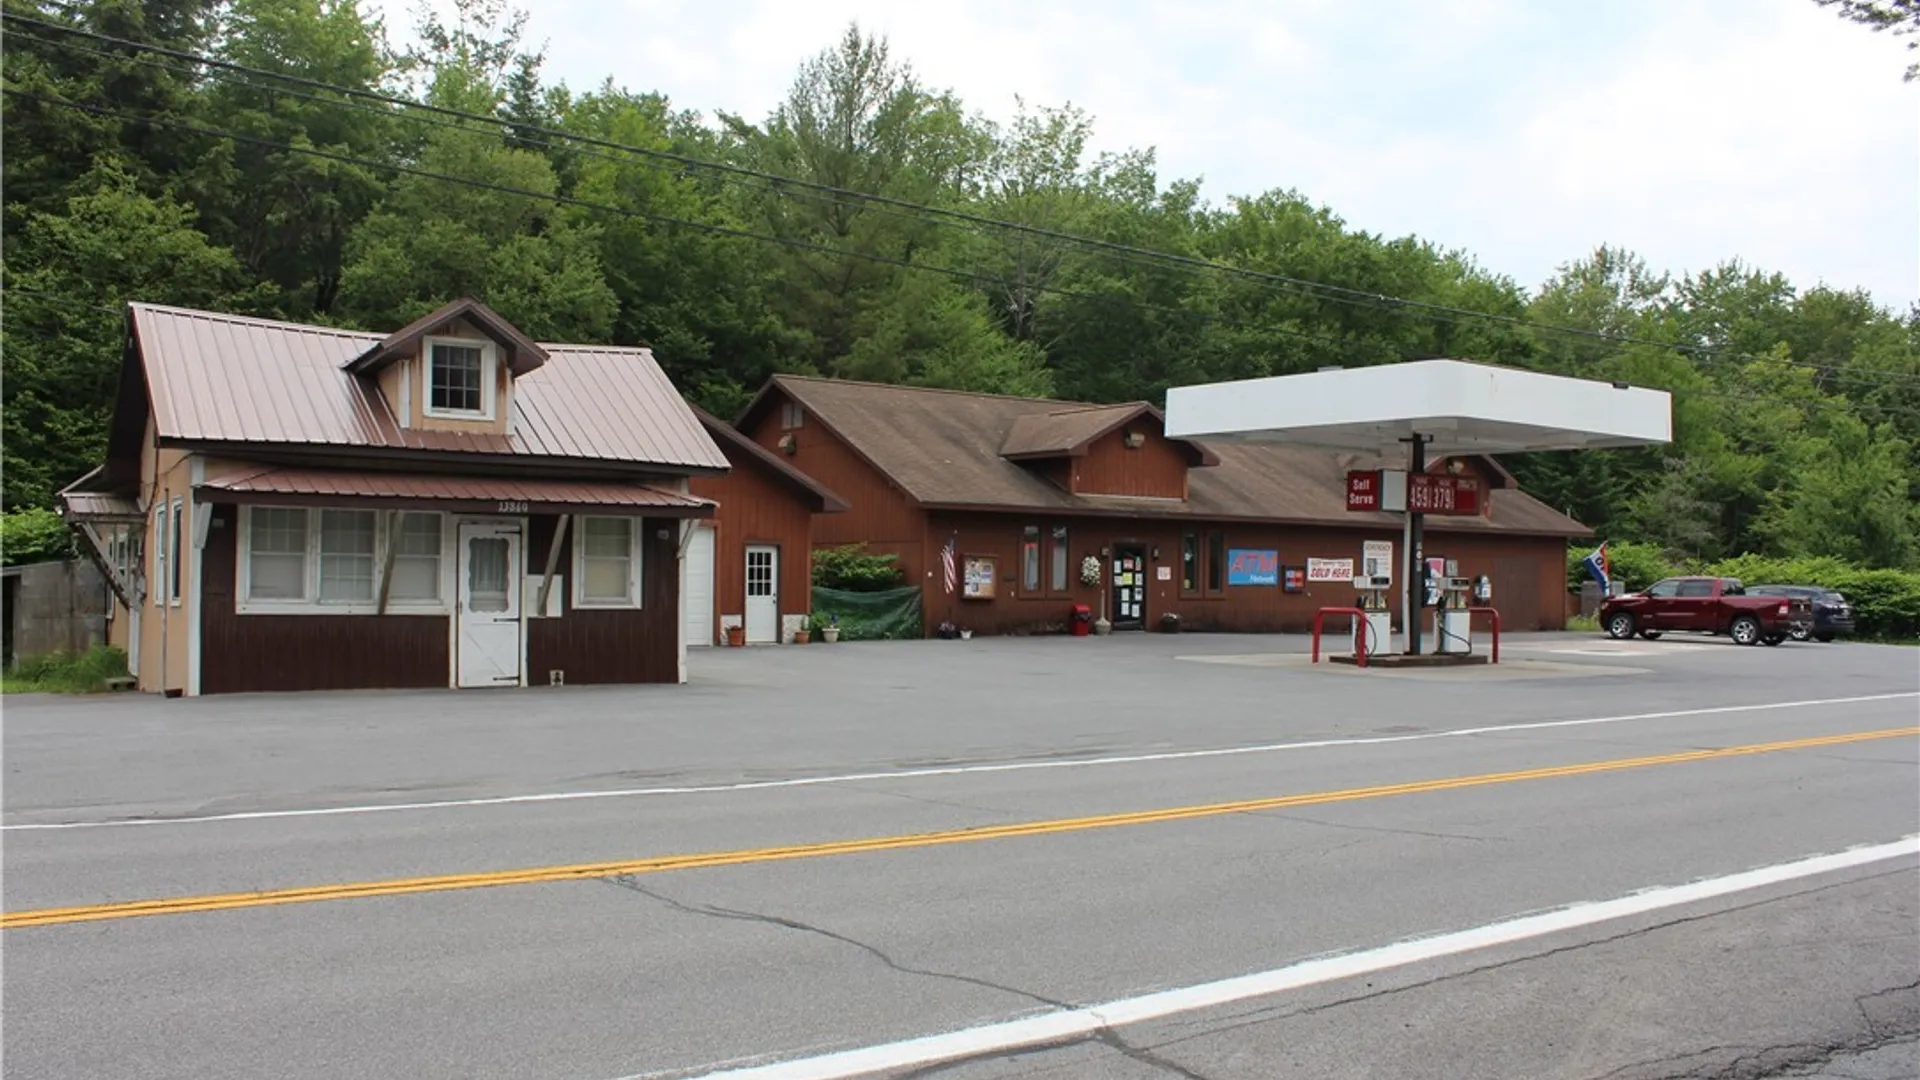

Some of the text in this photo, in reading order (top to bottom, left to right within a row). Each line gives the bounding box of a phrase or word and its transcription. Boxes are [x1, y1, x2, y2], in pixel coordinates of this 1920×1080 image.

[1353, 479, 1370, 490] Self
[1349, 492, 1373, 504] Serve
[1231, 553, 1277, 572] ATM
[1311, 568, 1350, 578] SOLD HERE
